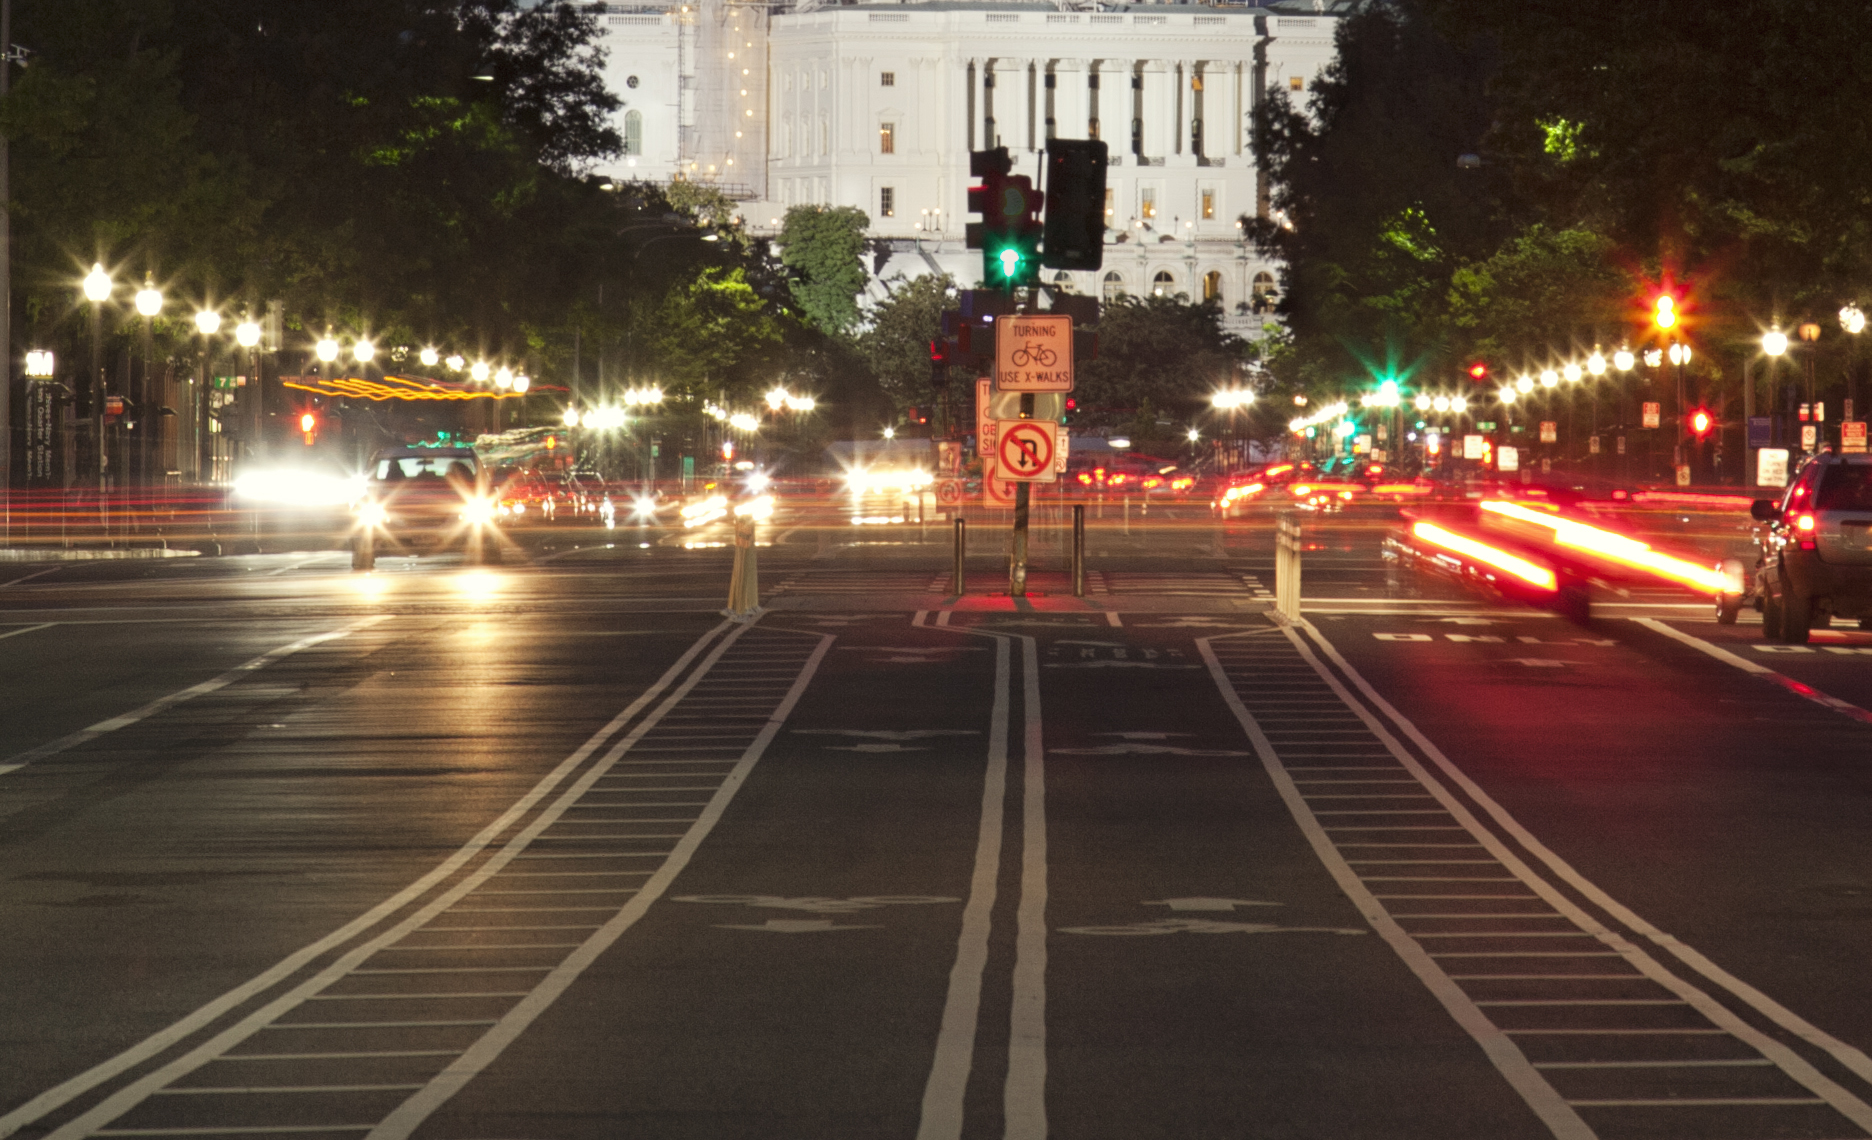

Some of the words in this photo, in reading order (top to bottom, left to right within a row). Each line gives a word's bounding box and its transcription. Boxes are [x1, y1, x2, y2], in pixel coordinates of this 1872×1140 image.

[1013, 325, 1056, 337] TURNING
[1001, 371, 1020, 383] USE
[1025, 371, 1069, 383] X-WALKS
[37, 406, 45, 440] Quarter
[1372, 633, 1619, 647] ONLY
